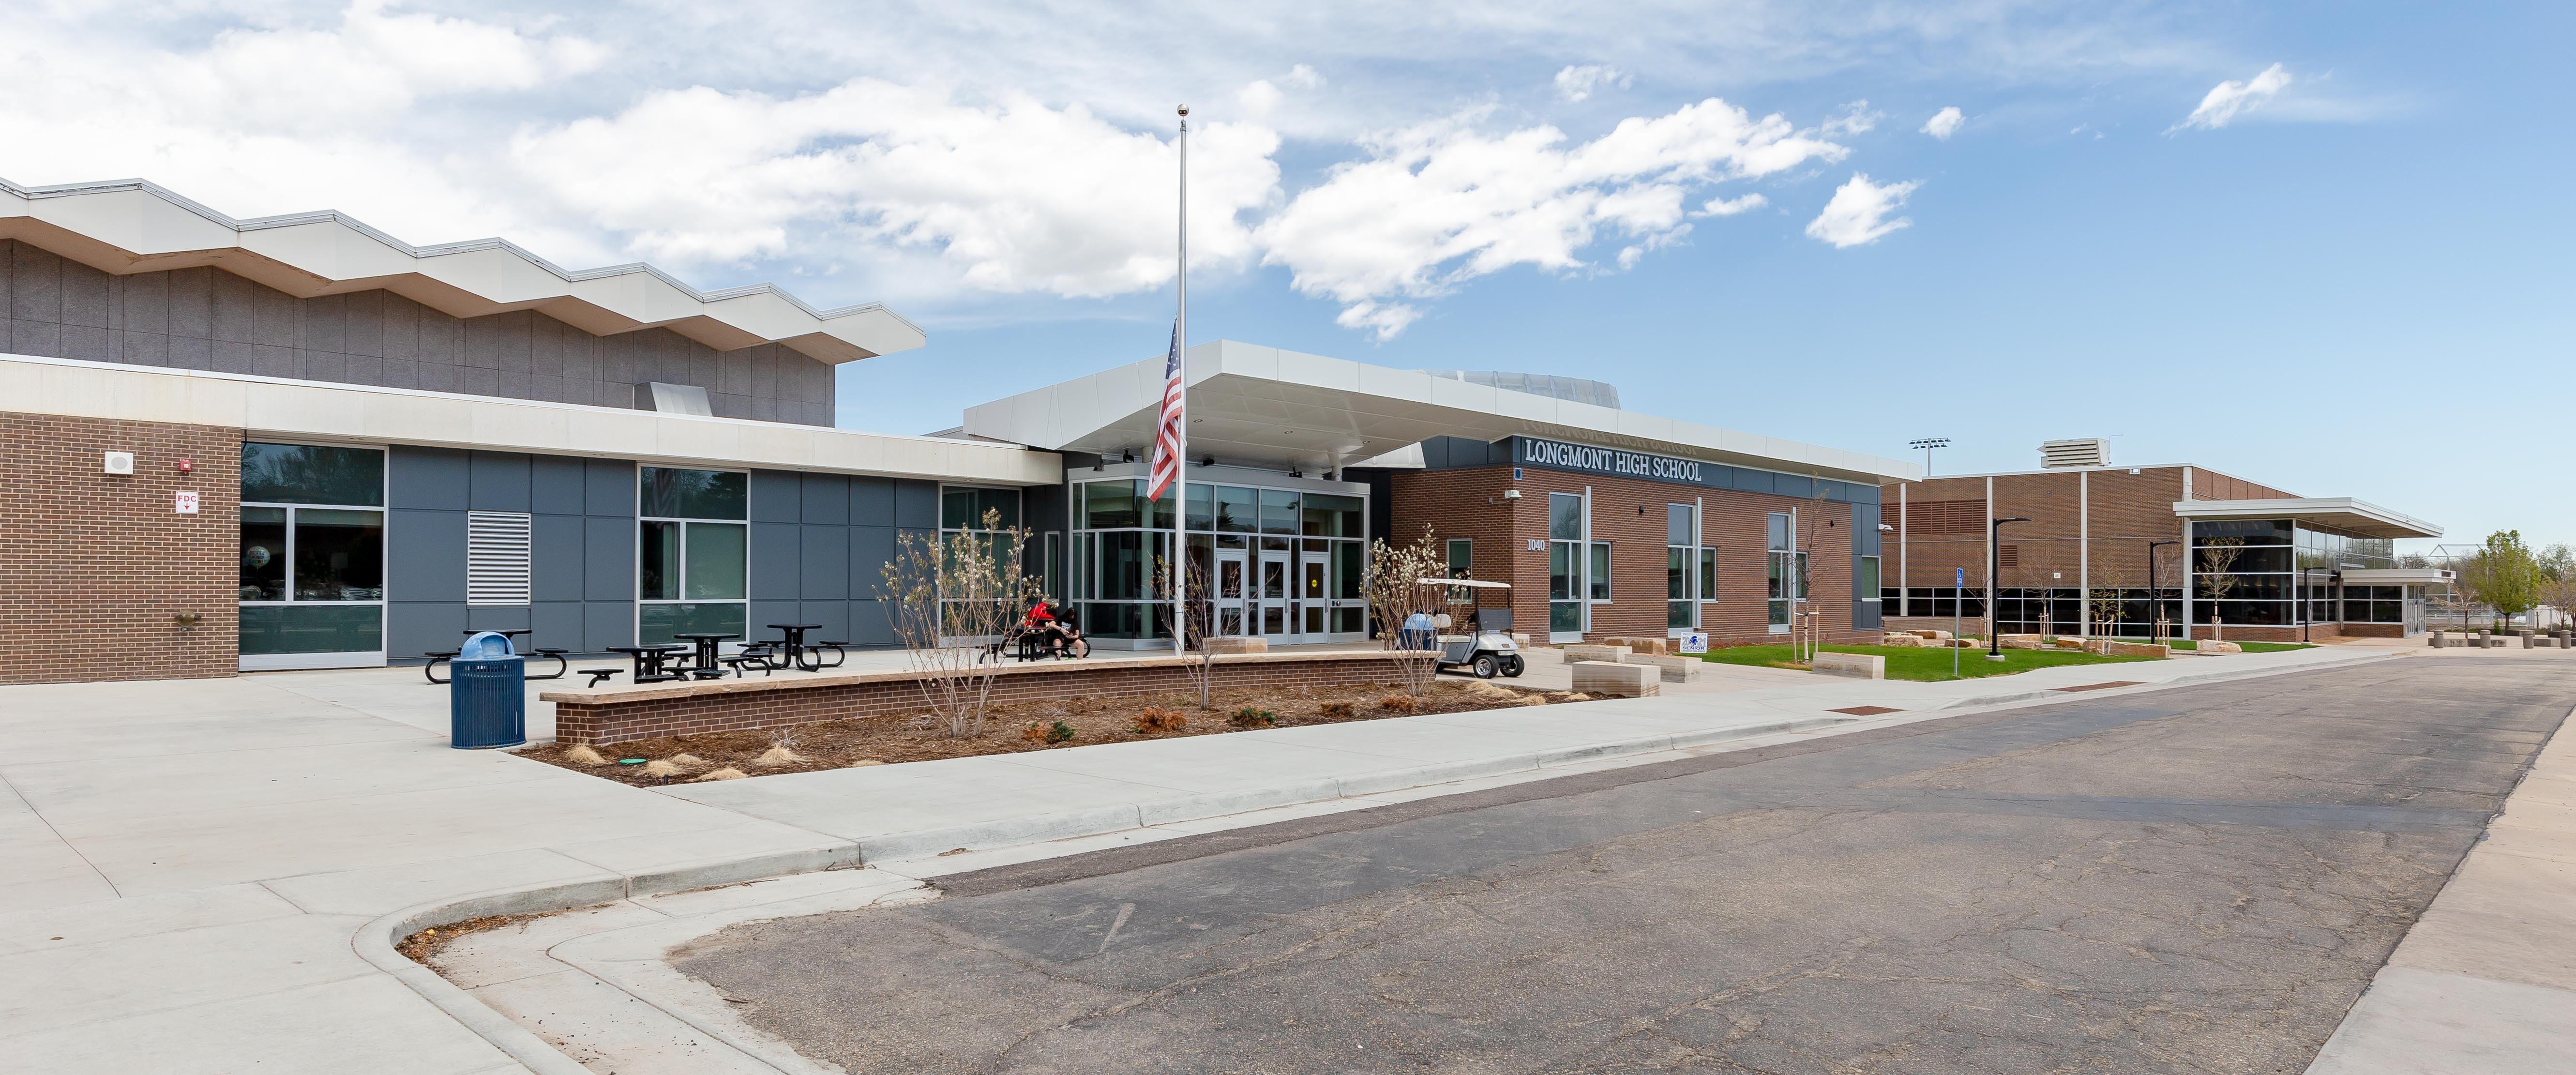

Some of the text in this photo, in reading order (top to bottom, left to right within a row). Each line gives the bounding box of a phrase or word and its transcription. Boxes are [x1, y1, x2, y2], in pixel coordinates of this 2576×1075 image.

[1526, 439, 1702, 481] LONGMONT HIGH SCHOOL
[1527, 539, 1545, 551] 1040
